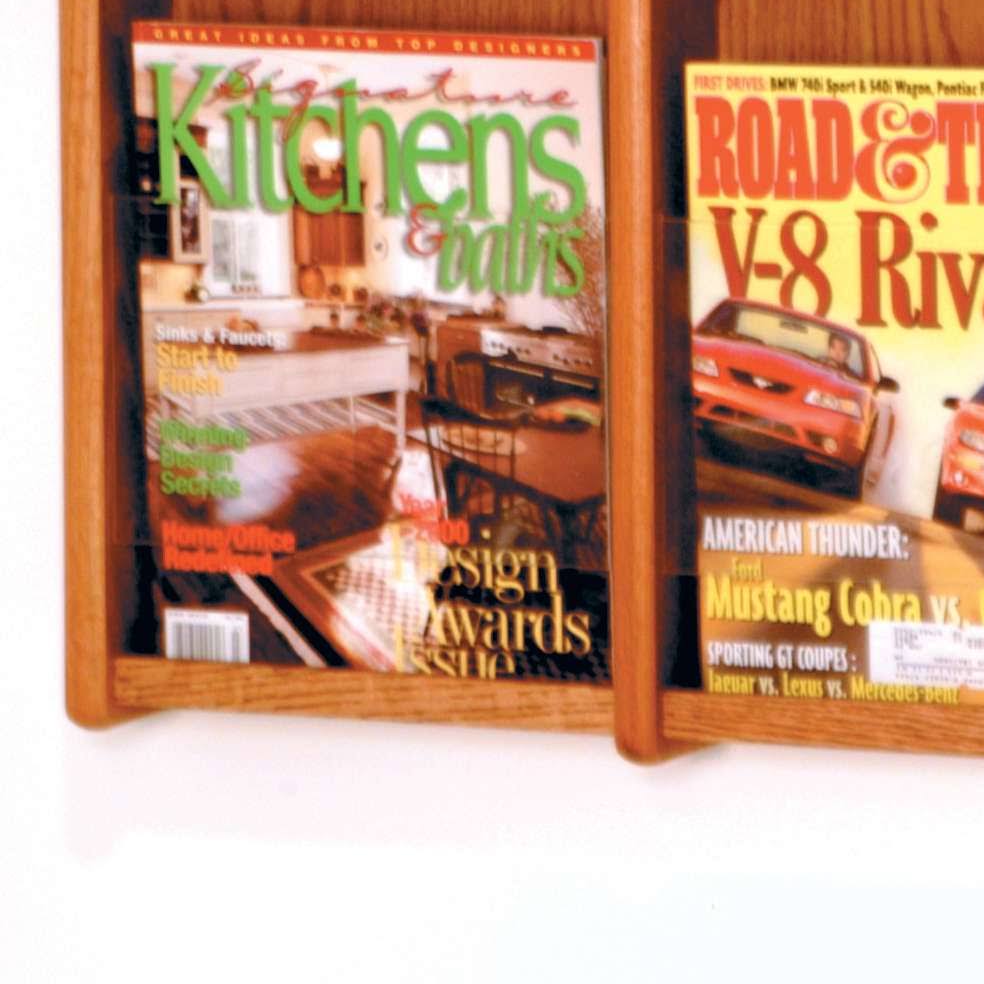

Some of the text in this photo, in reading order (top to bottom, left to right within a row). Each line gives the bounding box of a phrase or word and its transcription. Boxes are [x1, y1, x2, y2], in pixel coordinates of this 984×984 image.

[154, 29, 581, 57] GREAT IDEAS FROM TOP DESIGNERS
[770, 77, 798, 91] BMW
[827, 78, 856, 96] Sport
[937, 81, 977, 96] Pontiac
[148, 62, 587, 224] Kitchens
[407, 204, 446, 256] &
[707, 205, 833, 316] V-8
[156, 326, 198, 343] Sinks
[203, 332, 215, 344] &
[157, 343, 238, 371] Start to
[704, 516, 909, 559] AMERICAN THUNDER:
[732, 557, 762, 579] Ford
[706, 573, 832, 637] Mustang
[840, 579, 922, 625] Cobra
[418, 583, 592, 656] Awards
[708, 642, 773, 669] SPORTING
[777, 645, 794, 669] GT
[709, 670, 756, 696] Jaguar
[783, 671, 824, 698] Lexus
